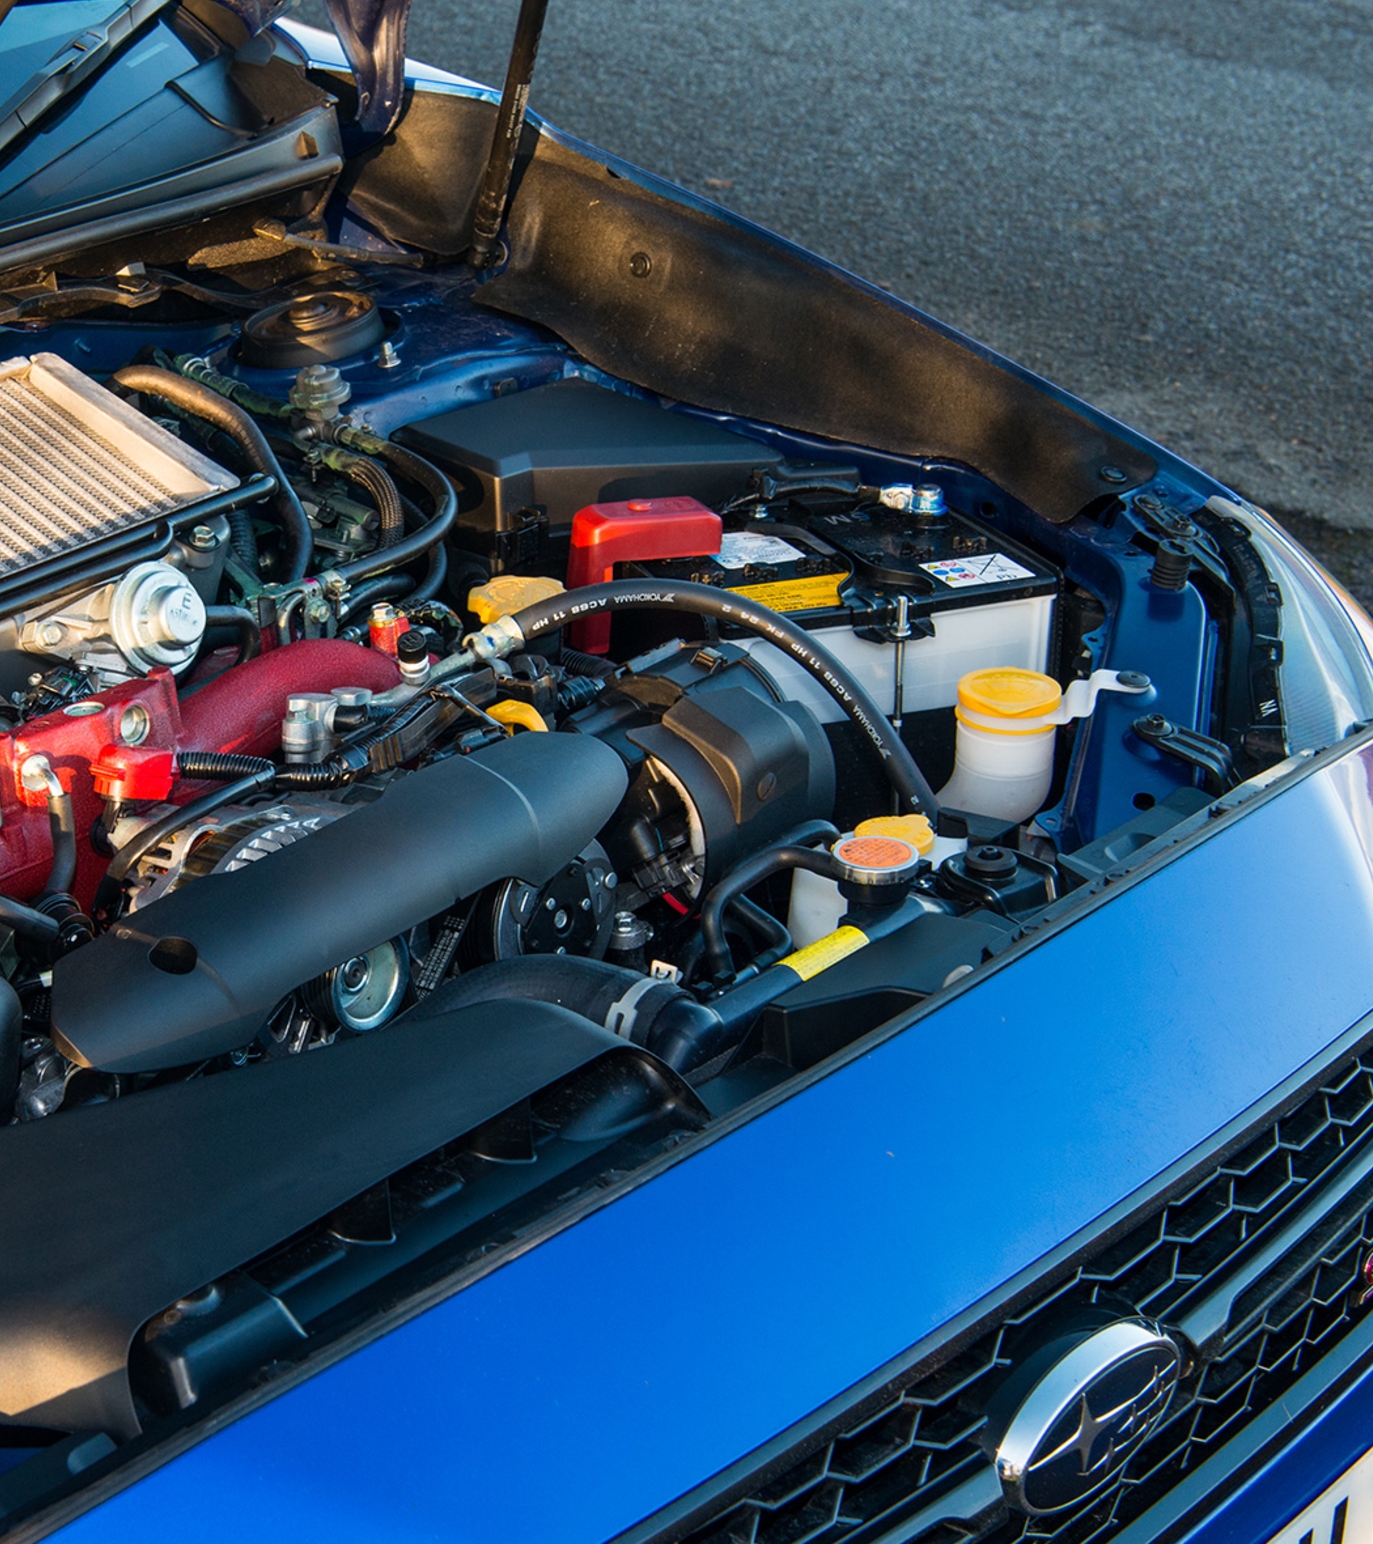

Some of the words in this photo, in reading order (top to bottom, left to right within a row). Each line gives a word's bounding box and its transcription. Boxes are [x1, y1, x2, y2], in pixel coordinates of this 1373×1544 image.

[613, 592, 662, 604] YOKOHAMA
[721, 603, 732, 614] 2
[552, 610, 567, 622] 11
[740, 611, 760, 625] 24
[532, 617, 550, 632] HP
[790, 642, 808, 658] HP
[809, 656, 822, 670] 11
[852, 704, 885, 748] YOKOHAMA
